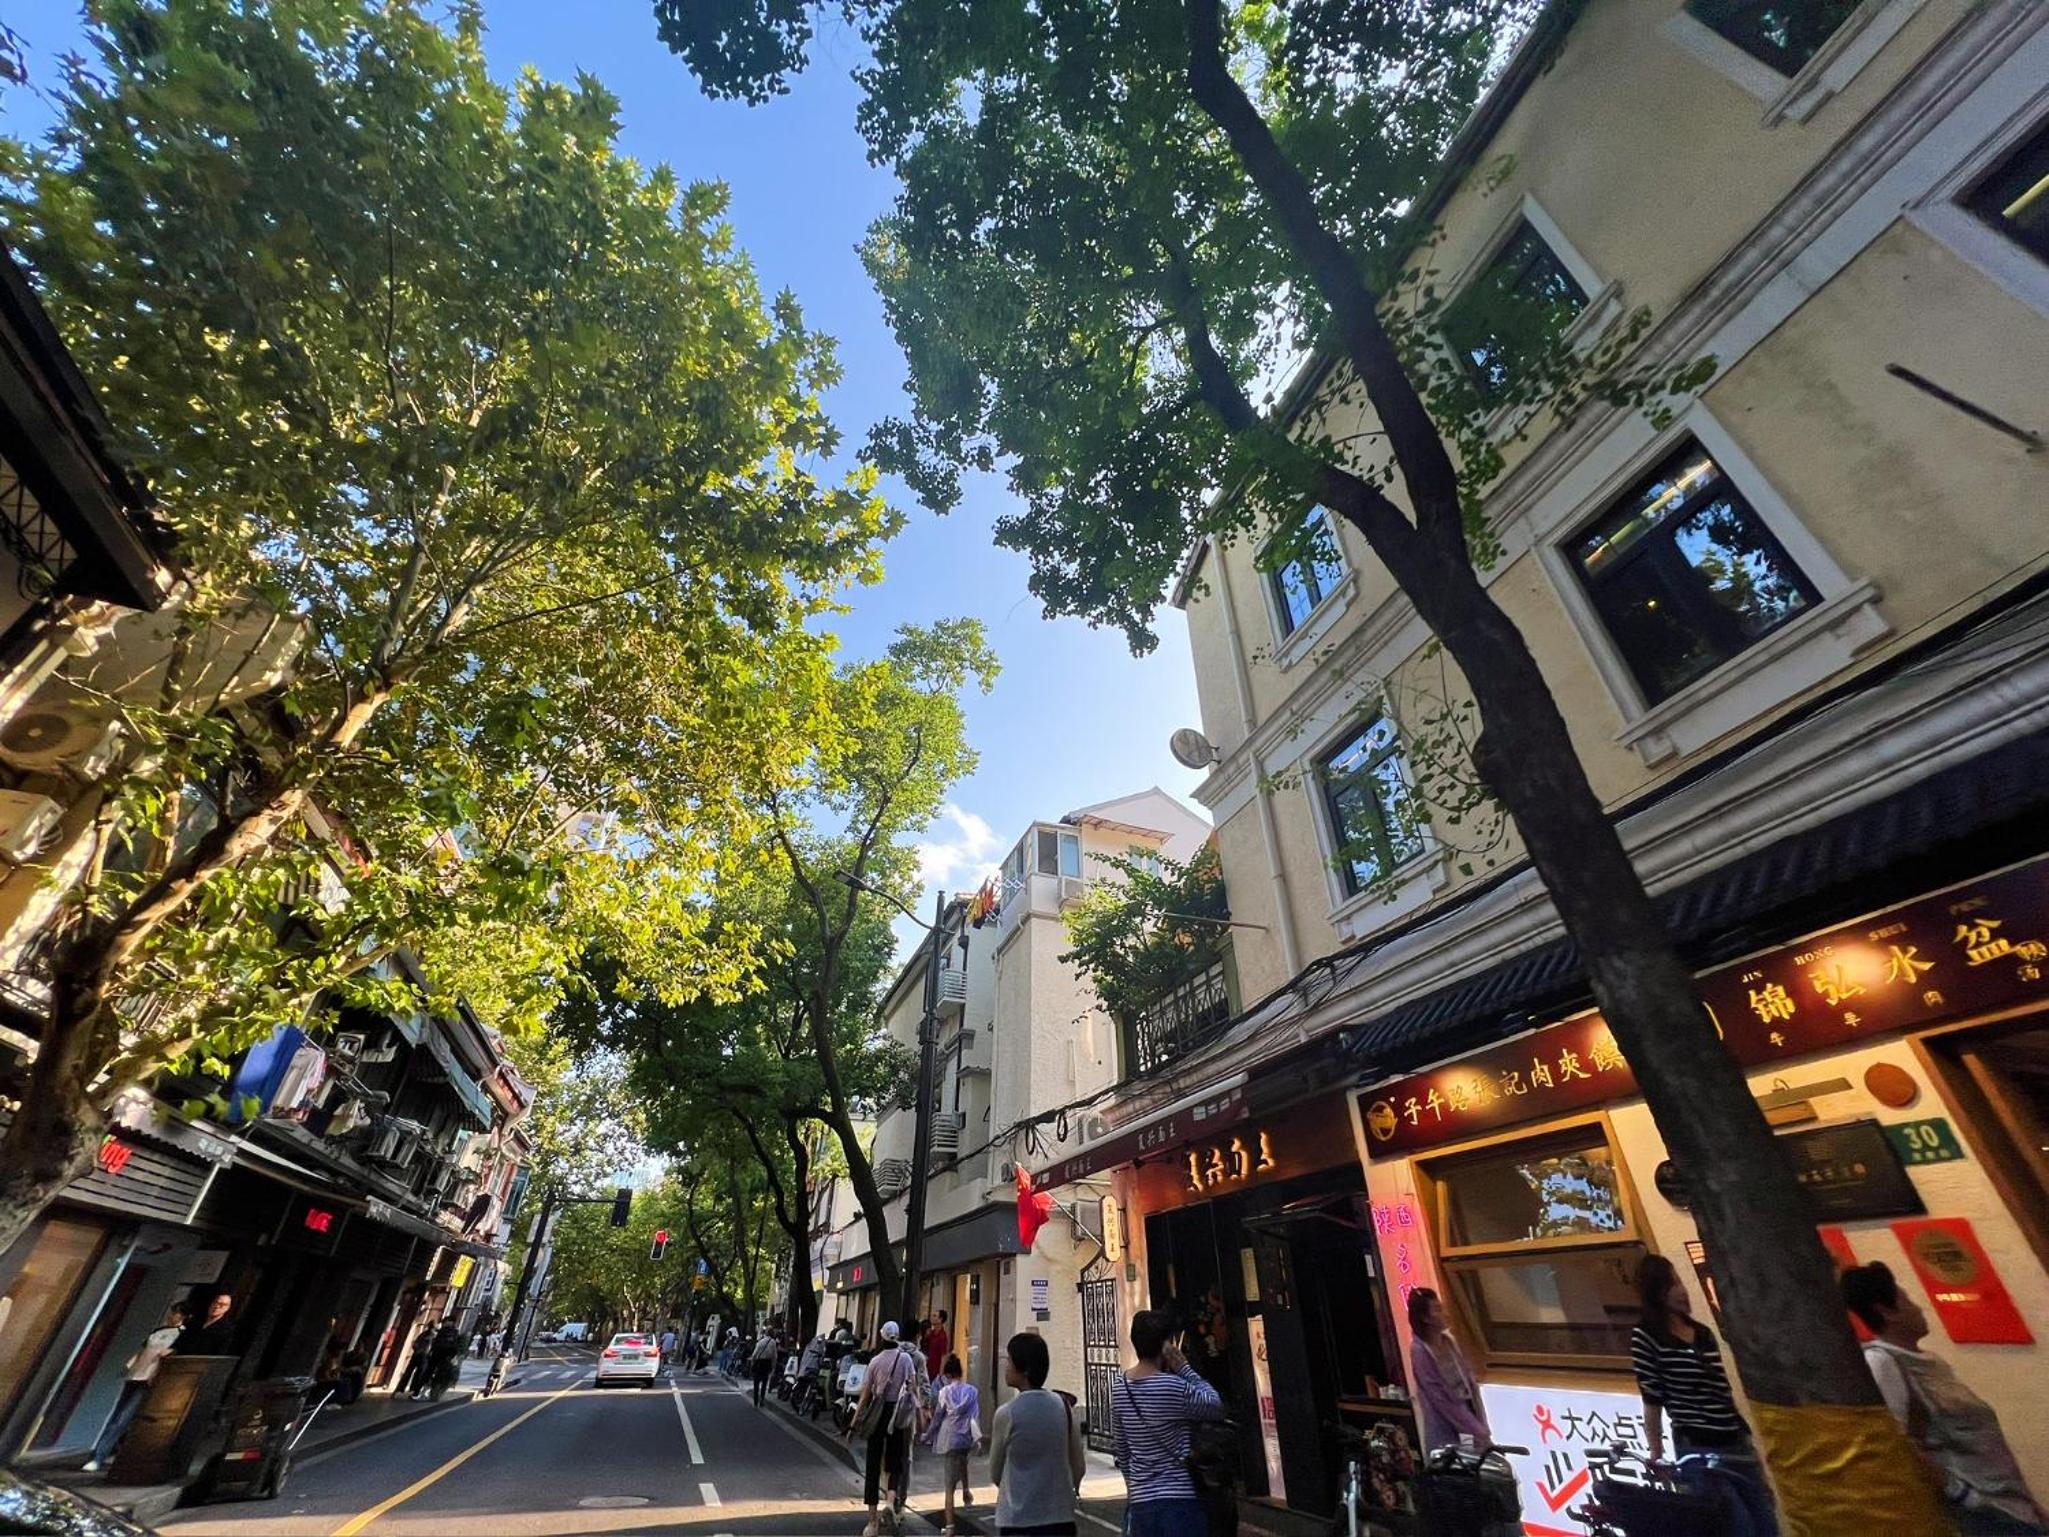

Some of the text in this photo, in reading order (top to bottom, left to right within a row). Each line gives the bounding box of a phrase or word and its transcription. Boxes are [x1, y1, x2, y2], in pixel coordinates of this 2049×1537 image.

[1742, 970, 1764, 984] JIN
[1794, 945, 1835, 967] HONG
[1748, 918, 2016, 1024] 锦弘水盆
[1902, 1125, 1940, 1149] 30
